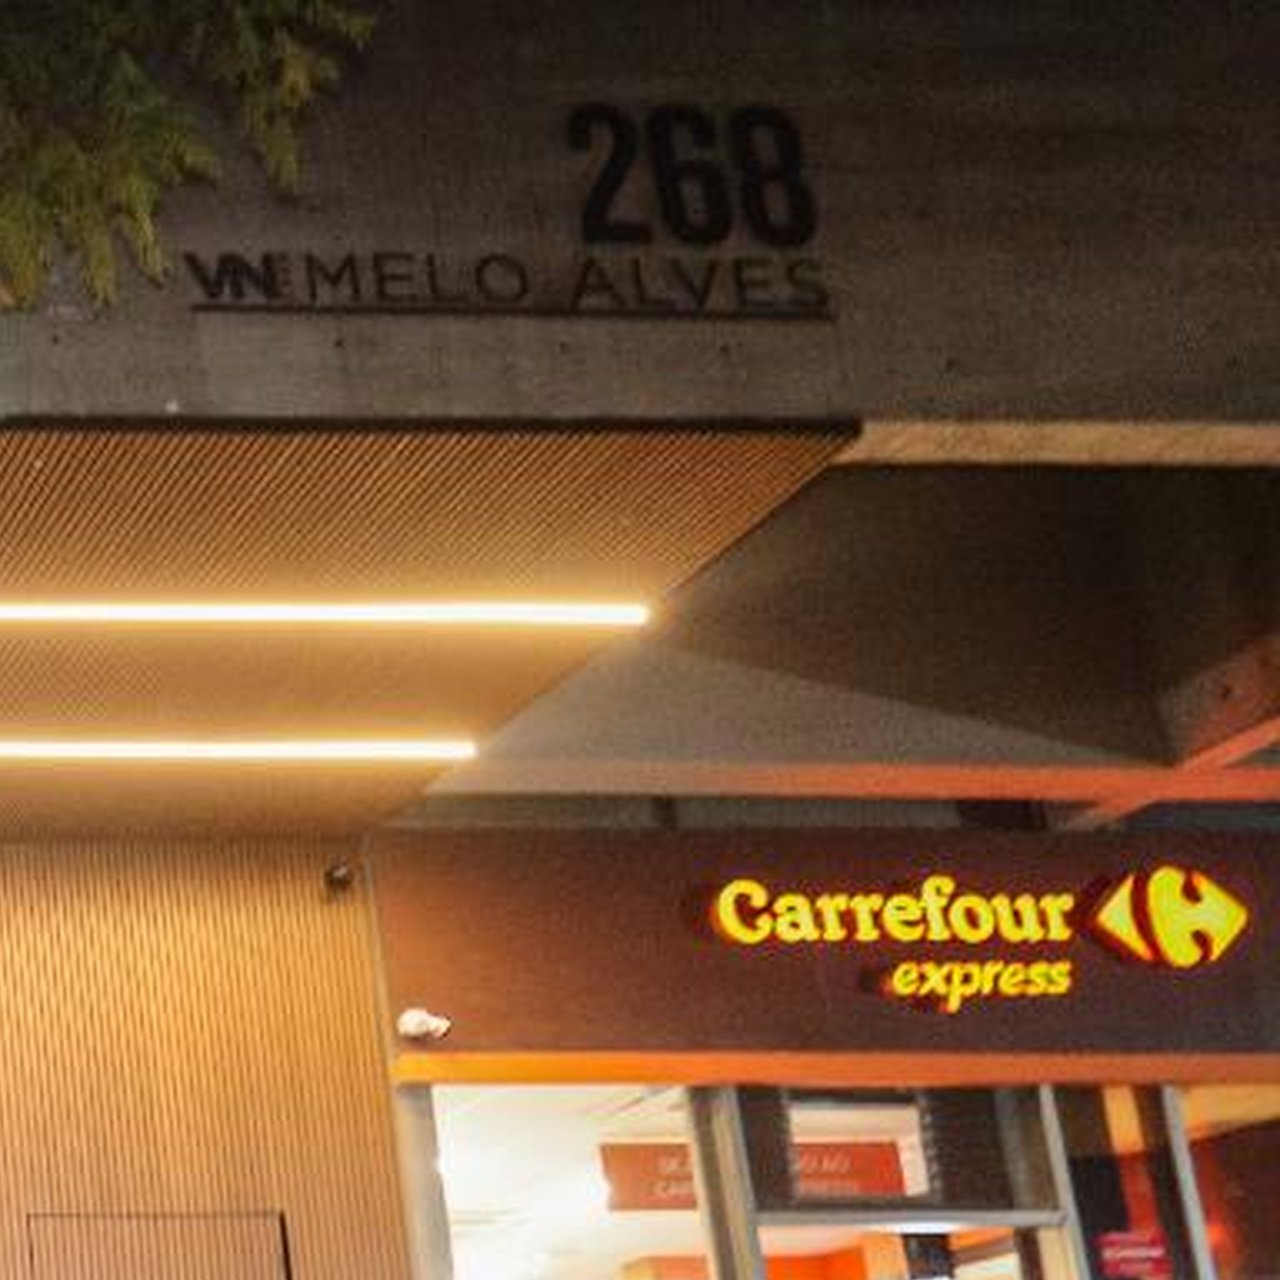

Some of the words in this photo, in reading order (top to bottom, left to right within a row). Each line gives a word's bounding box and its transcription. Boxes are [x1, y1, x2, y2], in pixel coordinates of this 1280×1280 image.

[563, 101, 818, 249] 268
[304, 251, 531, 304] MELO
[570, 255, 830, 309] ALVES
[716, 875, 1075, 945] Carrefour
[889, 959, 1071, 1014] express
